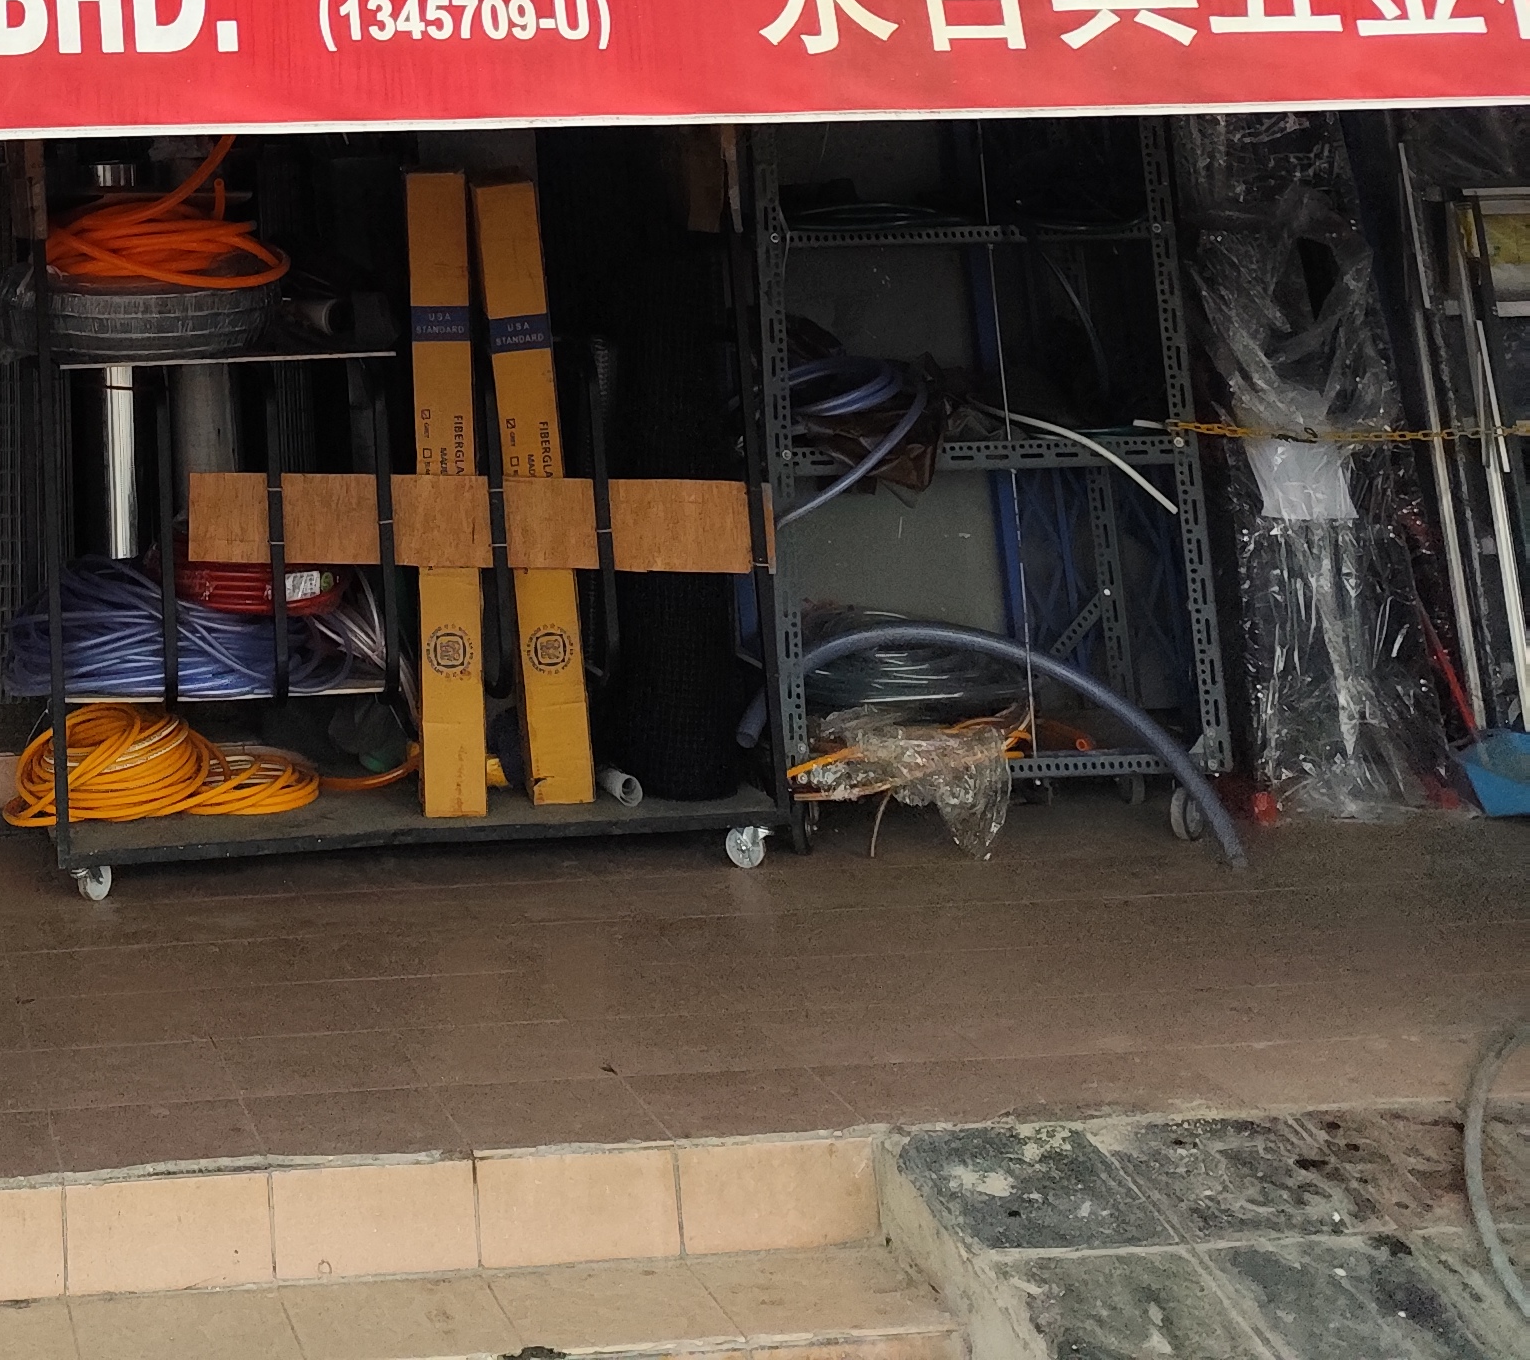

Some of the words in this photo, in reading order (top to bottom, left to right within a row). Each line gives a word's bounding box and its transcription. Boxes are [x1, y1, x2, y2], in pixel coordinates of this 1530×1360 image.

[416, 325, 465, 334] STANDARD
[507, 322, 530, 332] USA
[495, 333, 545, 346] STANDARD
